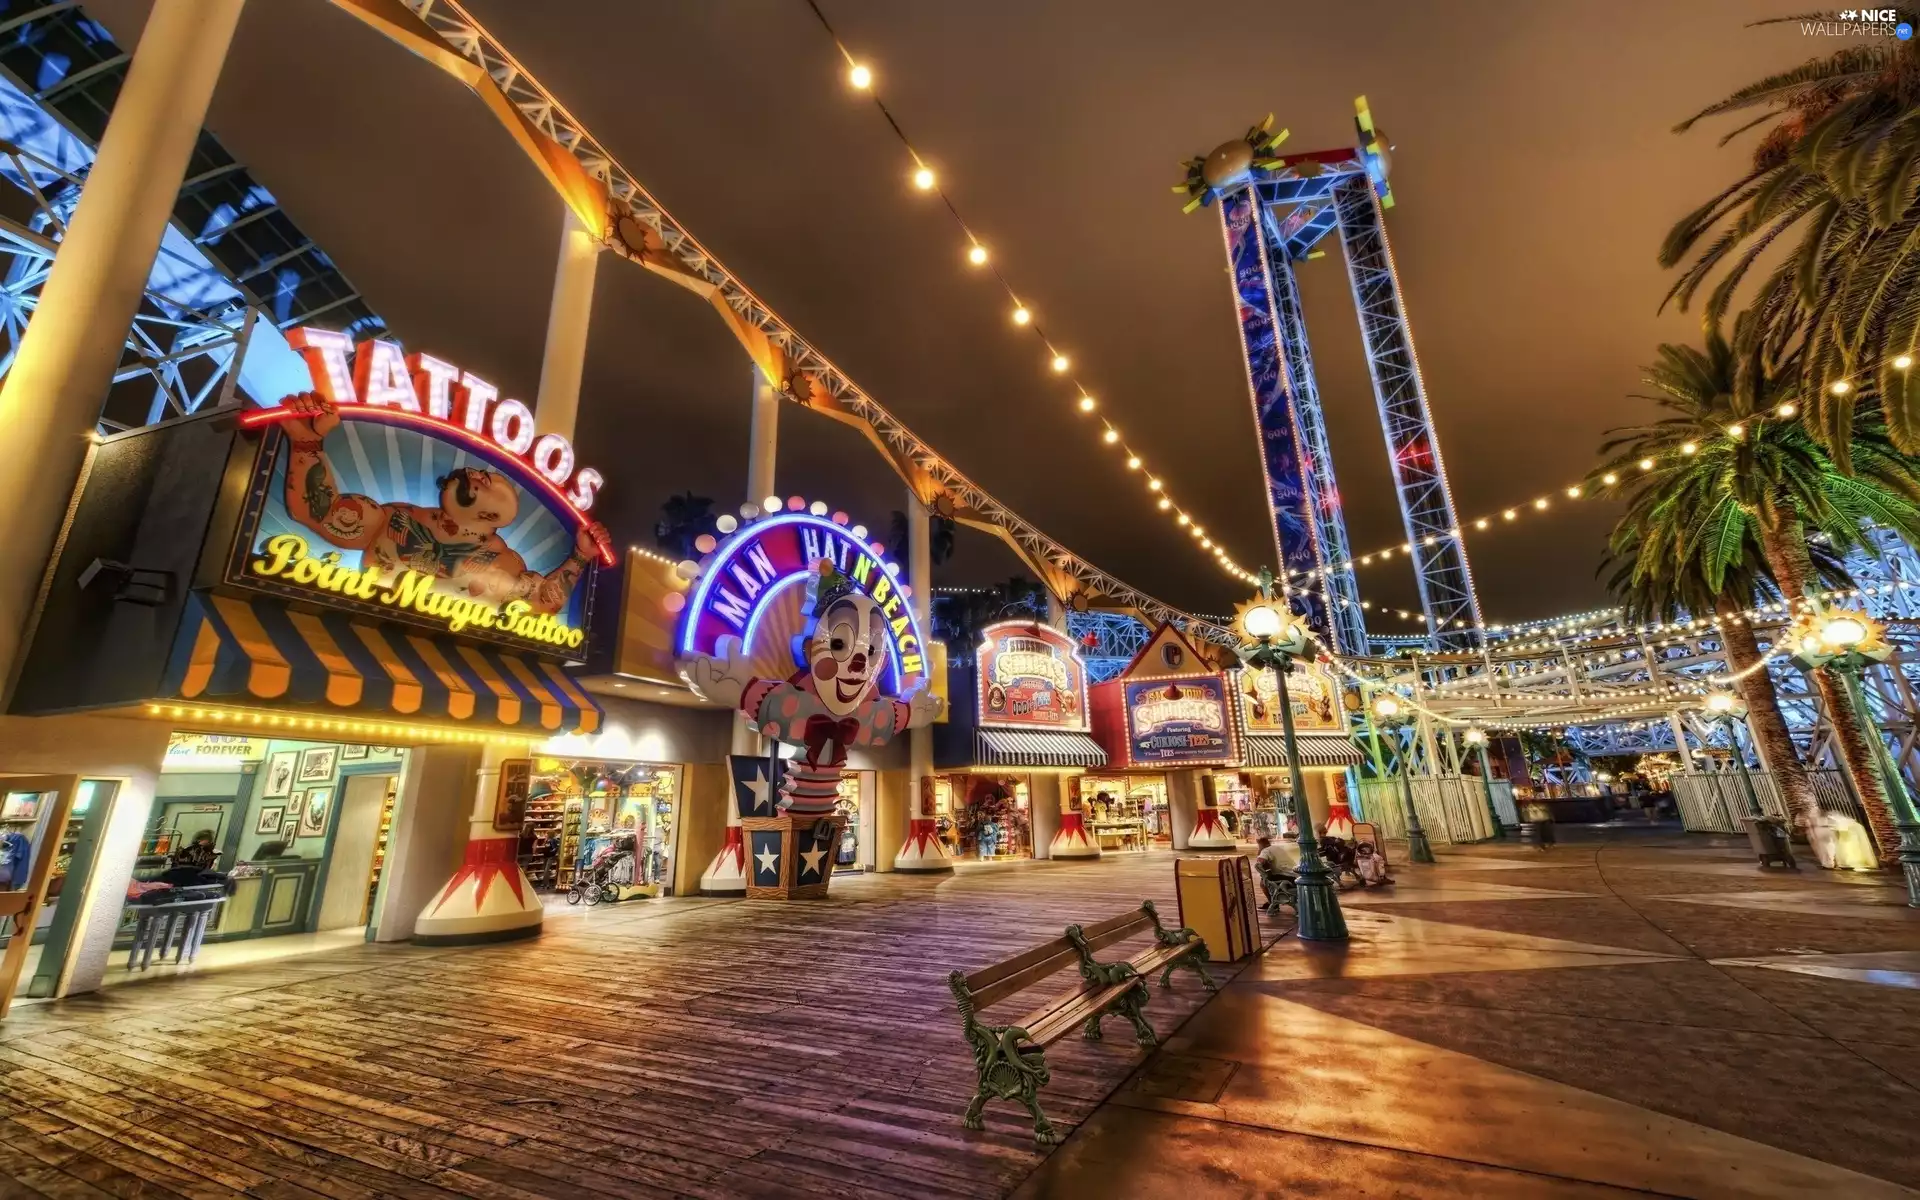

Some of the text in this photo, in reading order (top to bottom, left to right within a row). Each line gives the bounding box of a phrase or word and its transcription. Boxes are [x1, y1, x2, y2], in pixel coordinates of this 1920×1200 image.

[287, 327, 604, 512] TATTOOS
[1267, 426, 1289, 440] 600
[253, 534, 584, 649] Point Mugu Tattoo
[711, 541, 778, 631] MAN
[802, 527, 853, 572] HAT
[873, 574, 923, 675] BEACH
[195, 745, 252, 755] FOREVER
